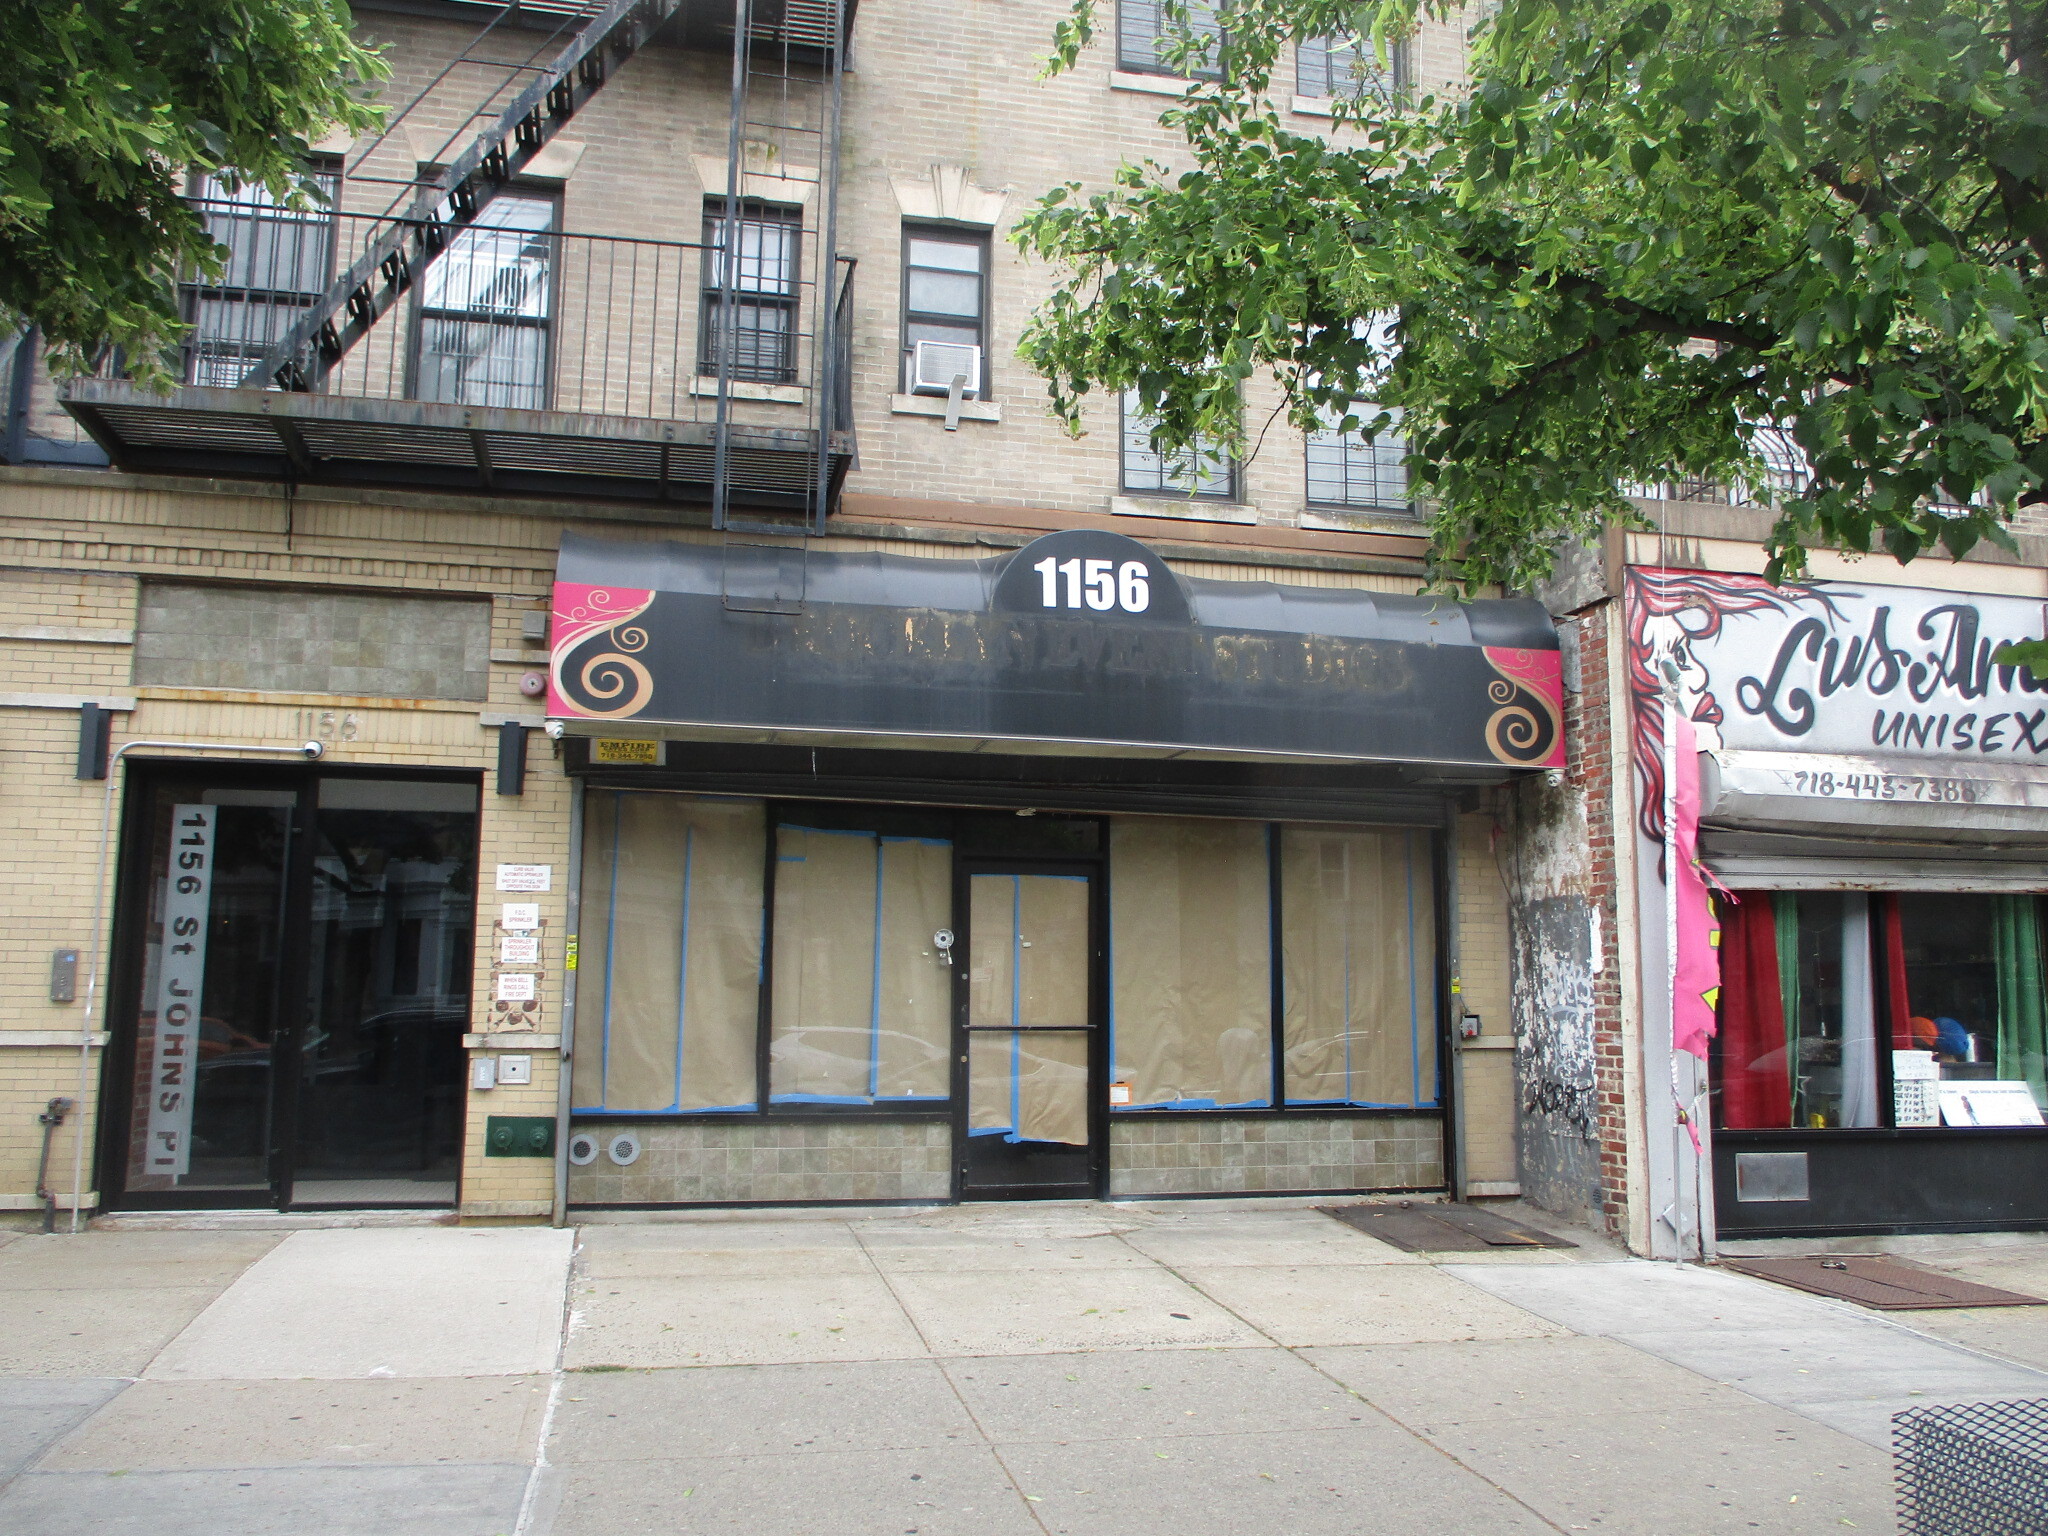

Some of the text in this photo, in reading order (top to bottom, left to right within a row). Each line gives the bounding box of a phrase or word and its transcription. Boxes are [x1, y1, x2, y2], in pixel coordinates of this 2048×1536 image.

[1034, 556, 1149, 613] 1156
[296, 711, 357, 740] 1156
[600, 741, 655, 750] EMPIRE
[1872, 708, 2048, 754] UNISEX
[1794, 770, 1976, 802] 718-443-7388
[177, 813, 207, 895] 1156
[172, 916, 199, 956] St
[159, 978, 193, 1113] JOHNS
